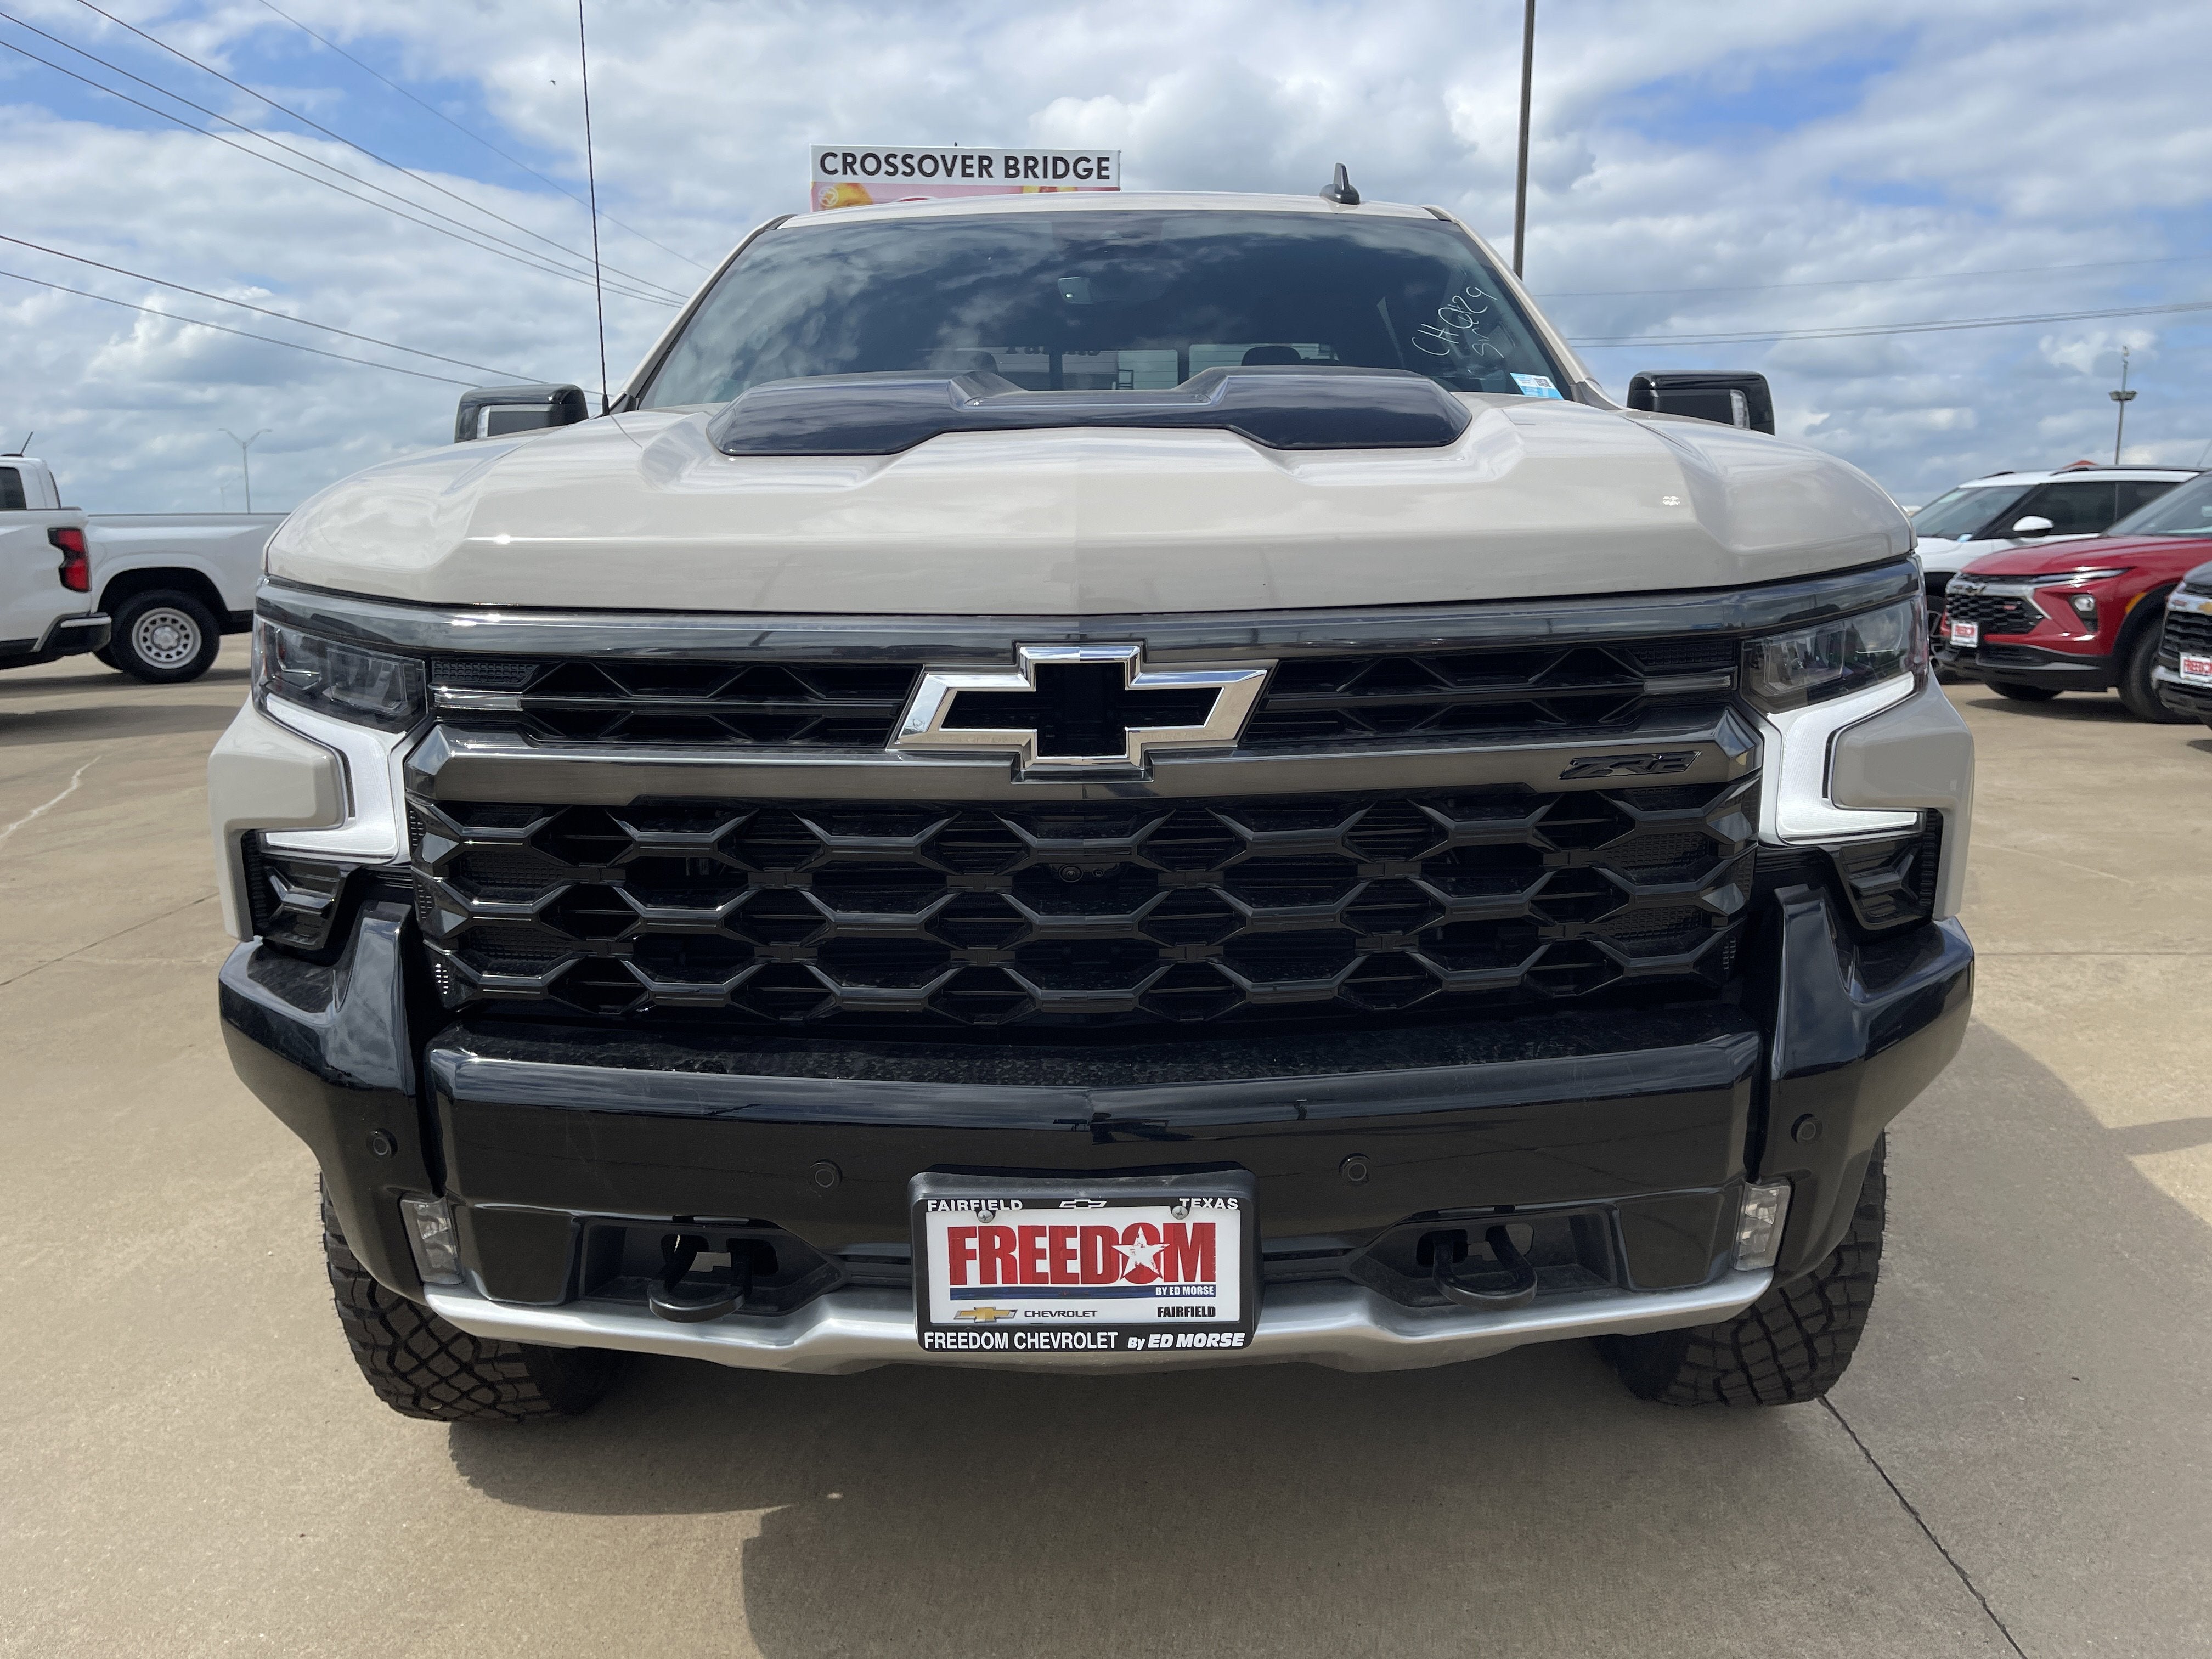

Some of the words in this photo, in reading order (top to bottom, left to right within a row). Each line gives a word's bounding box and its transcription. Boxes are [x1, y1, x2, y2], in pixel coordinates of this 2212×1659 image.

[819, 152, 994, 178] CROSSOVER
[1004, 155, 1110, 180] BRIDGE
[927, 1199, 1023, 1212] FAIRFIELD
[1179, 1198, 1238, 1210] TEXAS
[947, 1222, 1216, 1285] FREEDOM
[1155, 1286, 1167, 1296] BY
[1169, 1286, 1180, 1296] ED
[1182, 1286, 1214, 1295] MORSE
[1157, 1306, 1216, 1318] FAIRFIELD
[924, 1331, 1009, 1349] FREEDOM
[1014, 1331, 1118, 1350] CHEVROLET
[1127, 1336, 1146, 1351] By
[1147, 1334, 1174, 1348] ED
[1176, 1332, 1245, 1348] MORSE
